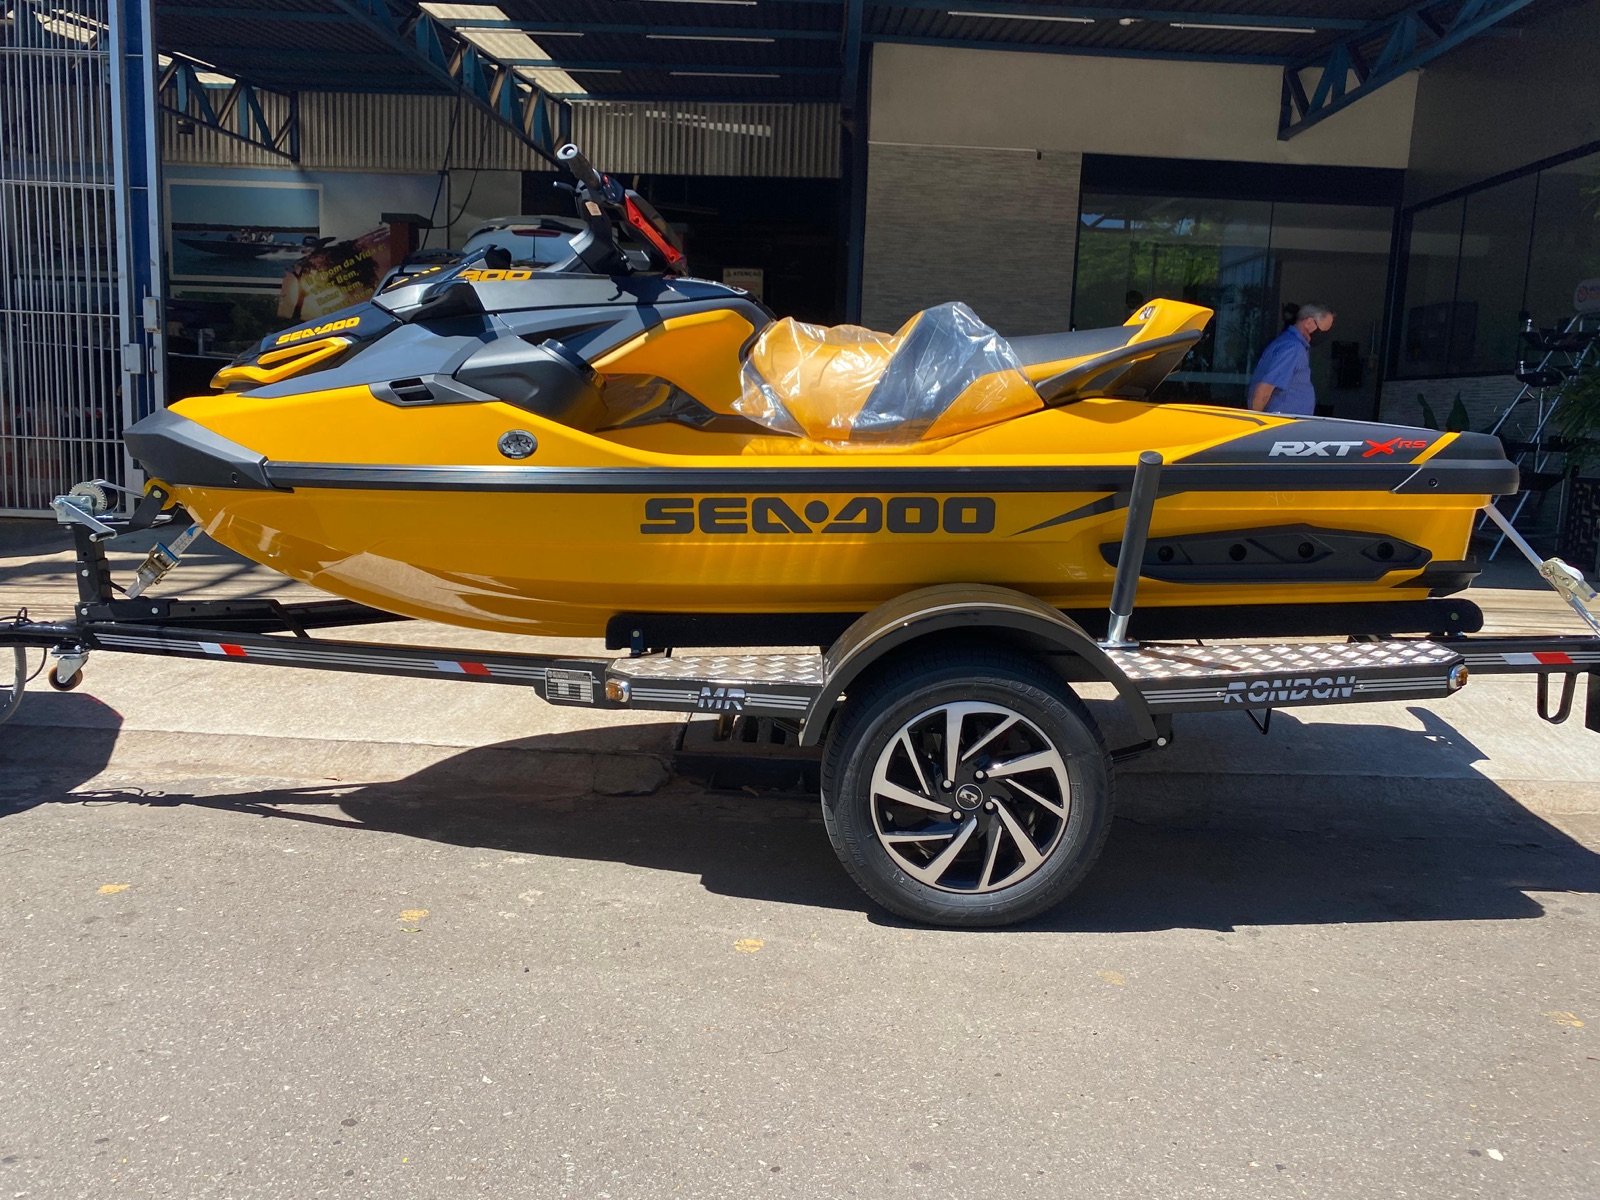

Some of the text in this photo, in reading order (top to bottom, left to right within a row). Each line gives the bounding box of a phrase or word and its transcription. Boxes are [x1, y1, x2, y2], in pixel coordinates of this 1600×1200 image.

[1268, 441, 1363, 457] RXT
[698, 686, 746, 711] MR
[1223, 676, 1356, 704] RONDON
